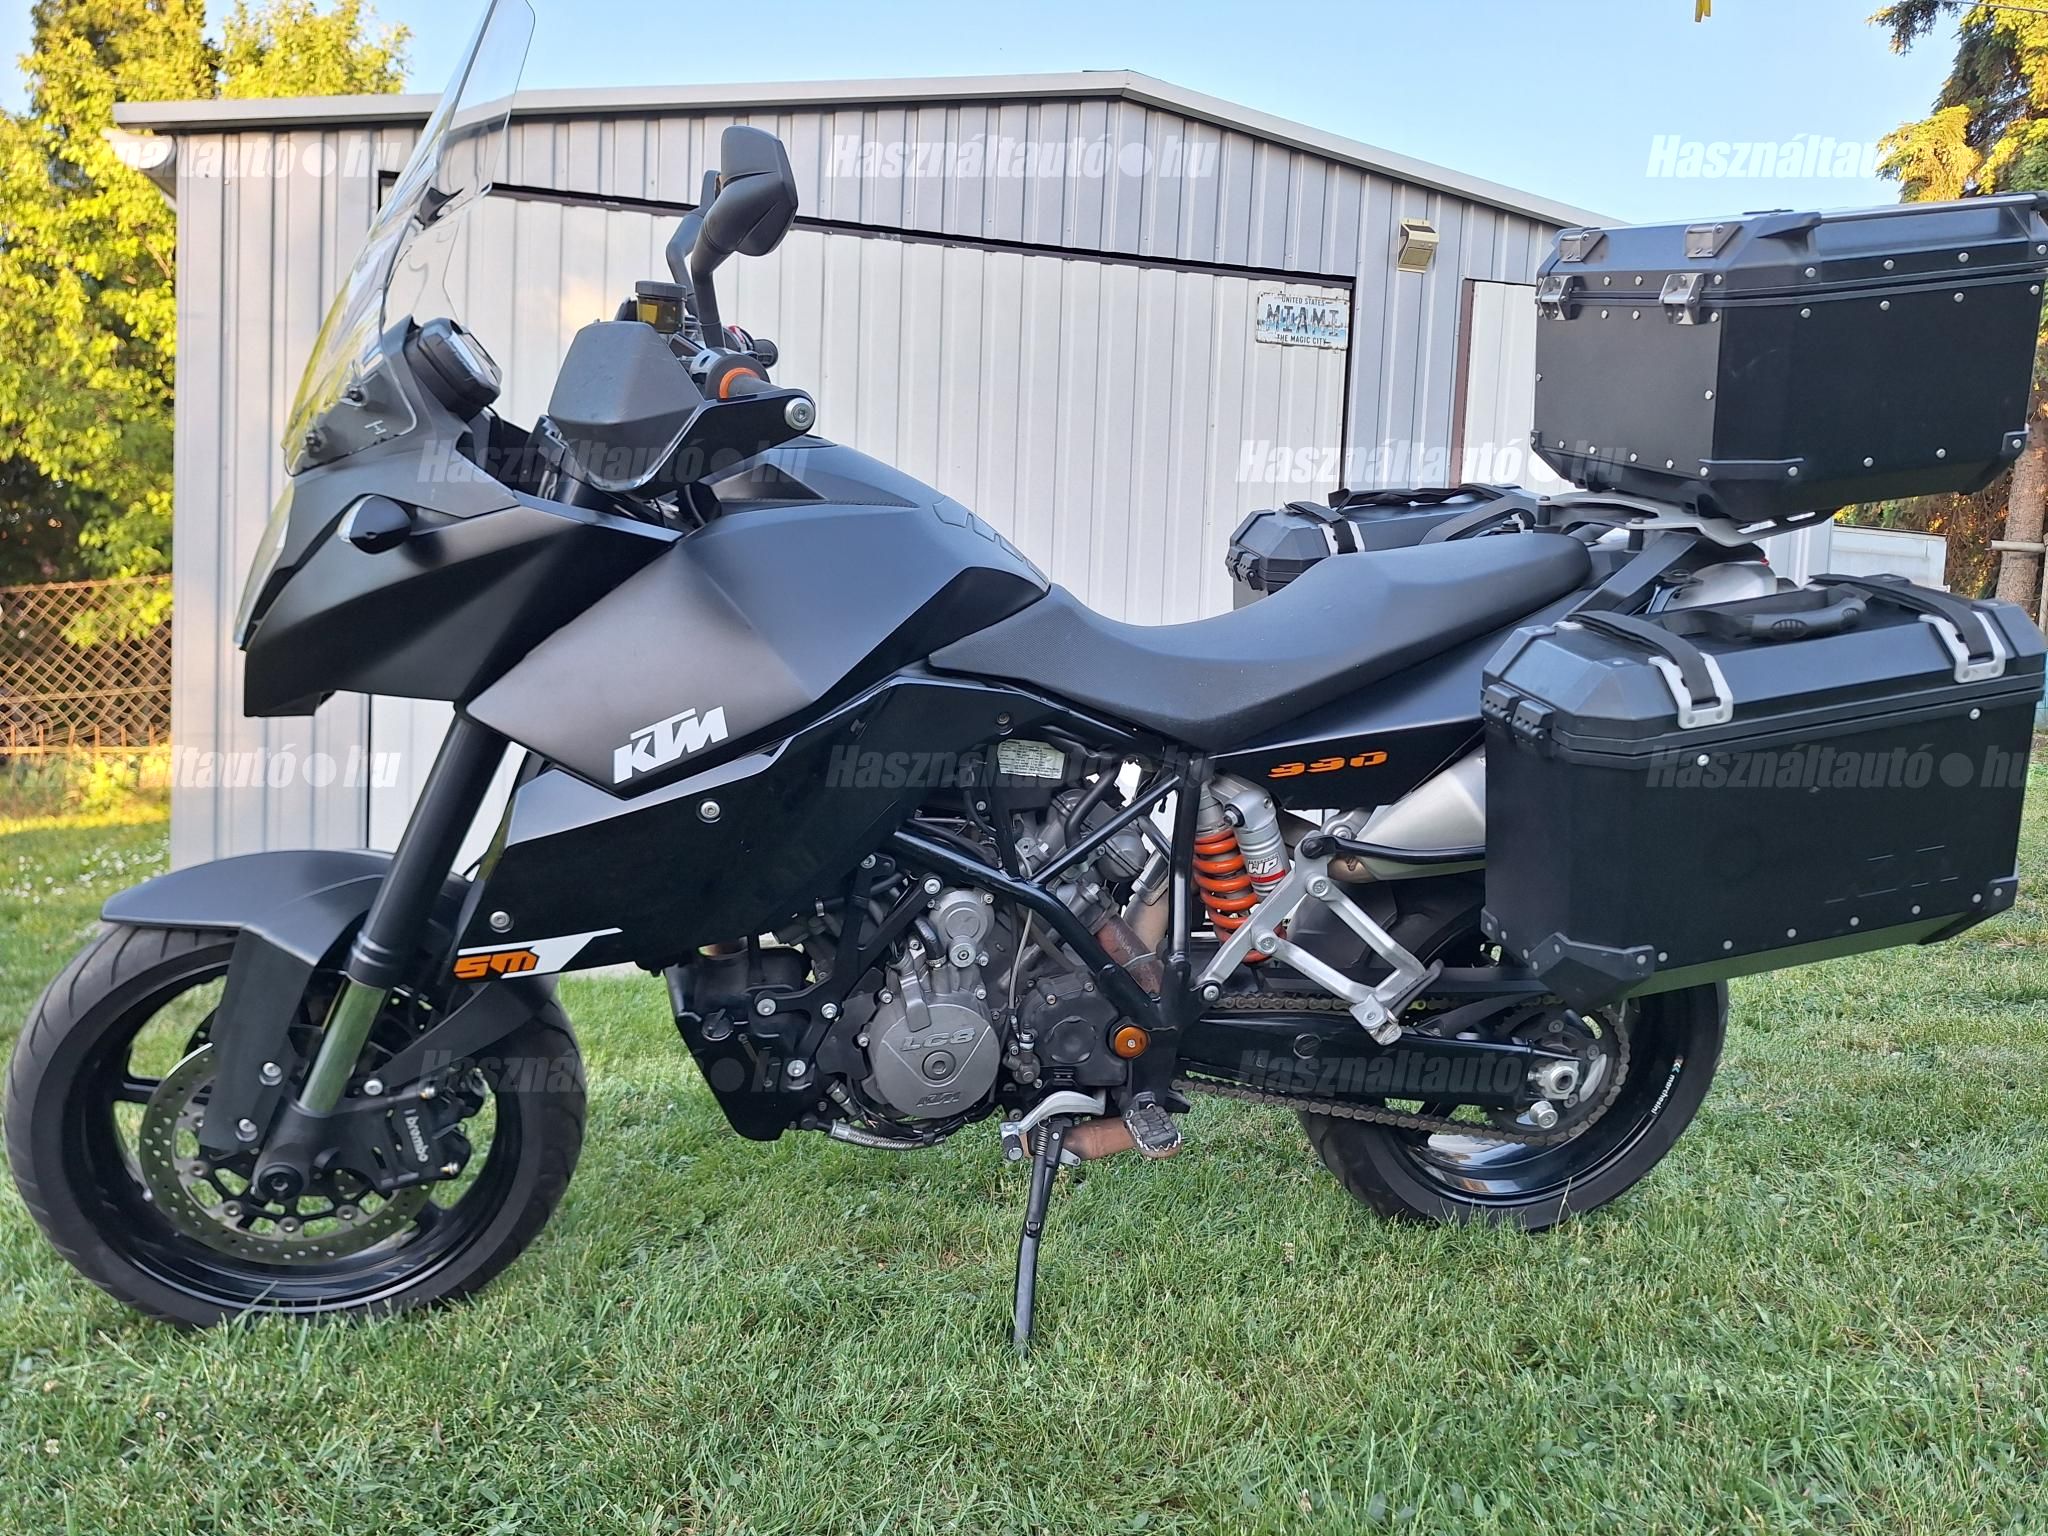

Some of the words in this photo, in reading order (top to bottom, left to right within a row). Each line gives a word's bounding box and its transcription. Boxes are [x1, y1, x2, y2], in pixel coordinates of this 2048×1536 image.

[1281, 296, 1303, 304] UNITED
[1266, 303, 1339, 337] MIAMI
[613, 705, 729, 785] KTM
[1267, 751, 1388, 778] 990
[1248, 857, 1278, 875] WP
[900, 1027, 976, 1052] LC8
[1650, 1073, 1676, 1115] marchesini
[405, 1115, 429, 1162] brembo
